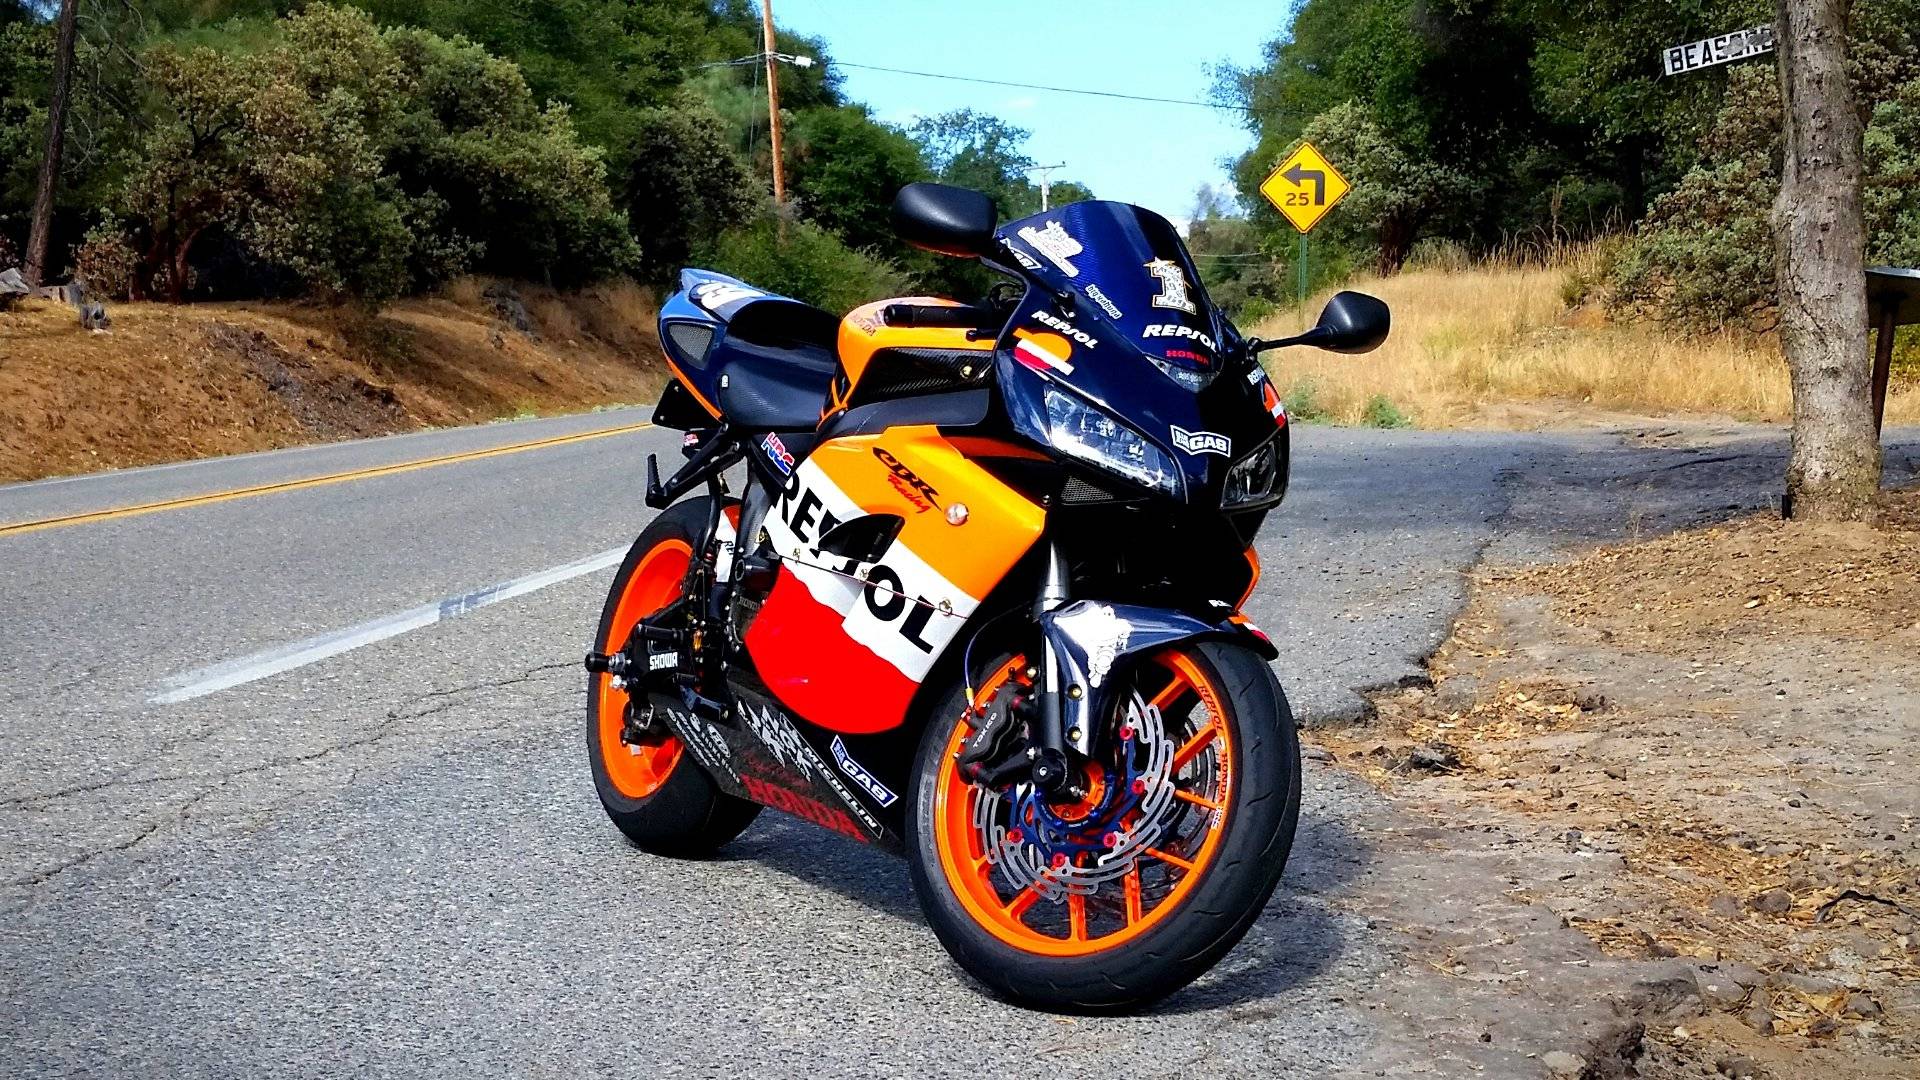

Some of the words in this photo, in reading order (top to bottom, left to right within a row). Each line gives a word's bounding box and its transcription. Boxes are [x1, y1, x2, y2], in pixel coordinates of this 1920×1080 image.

[1285, 192, 1310, 207] 25
[1031, 310, 1098, 349] REPSOL
[1142, 324, 1217, 353] REPSOL
[1166, 349, 1210, 366] HONDA
[761, 431, 796, 477] HRC
[872, 447, 942, 512] CBR
[649, 651, 679, 671] SHOWA
[972, 712, 997, 748] TOKICO
[803, 746, 878, 828] MICHELIN
[1217, 752, 1229, 803] HONDA
[739, 772, 871, 844] HONDA
